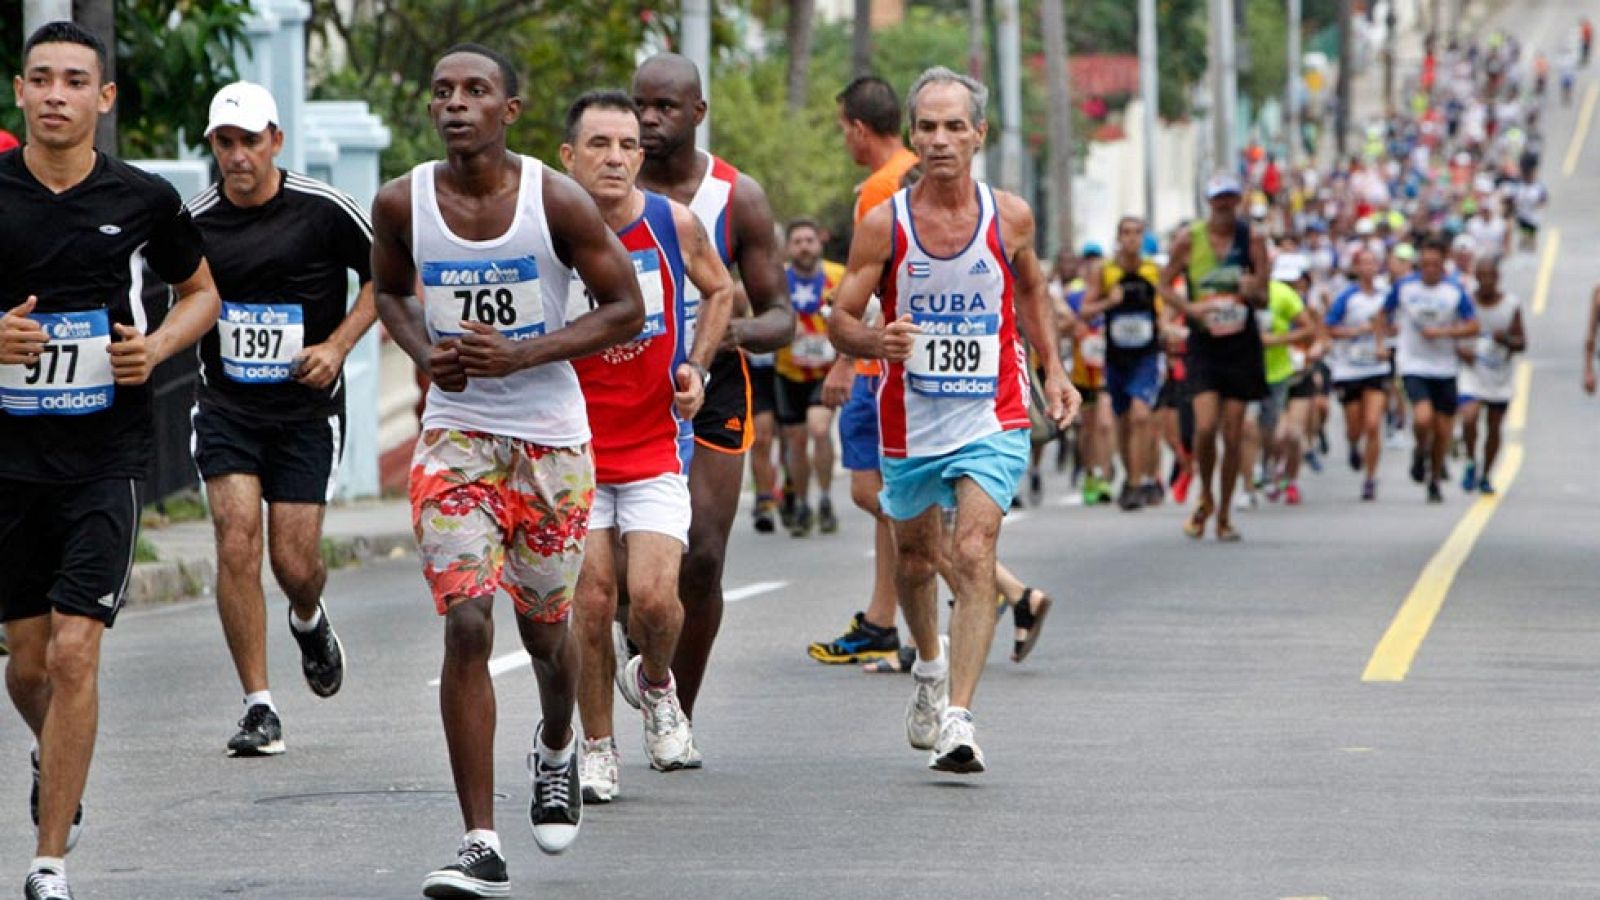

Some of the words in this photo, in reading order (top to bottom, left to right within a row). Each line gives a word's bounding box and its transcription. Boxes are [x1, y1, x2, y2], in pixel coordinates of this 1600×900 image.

[454, 288, 516, 325] 768
[910, 292, 986, 312] CUBA
[232, 328, 283, 358] 1397
[926, 340, 980, 371] 1389
[246, 364, 290, 378] adida
[941, 379, 995, 393] adidas
[41, 391, 108, 409] adidas
